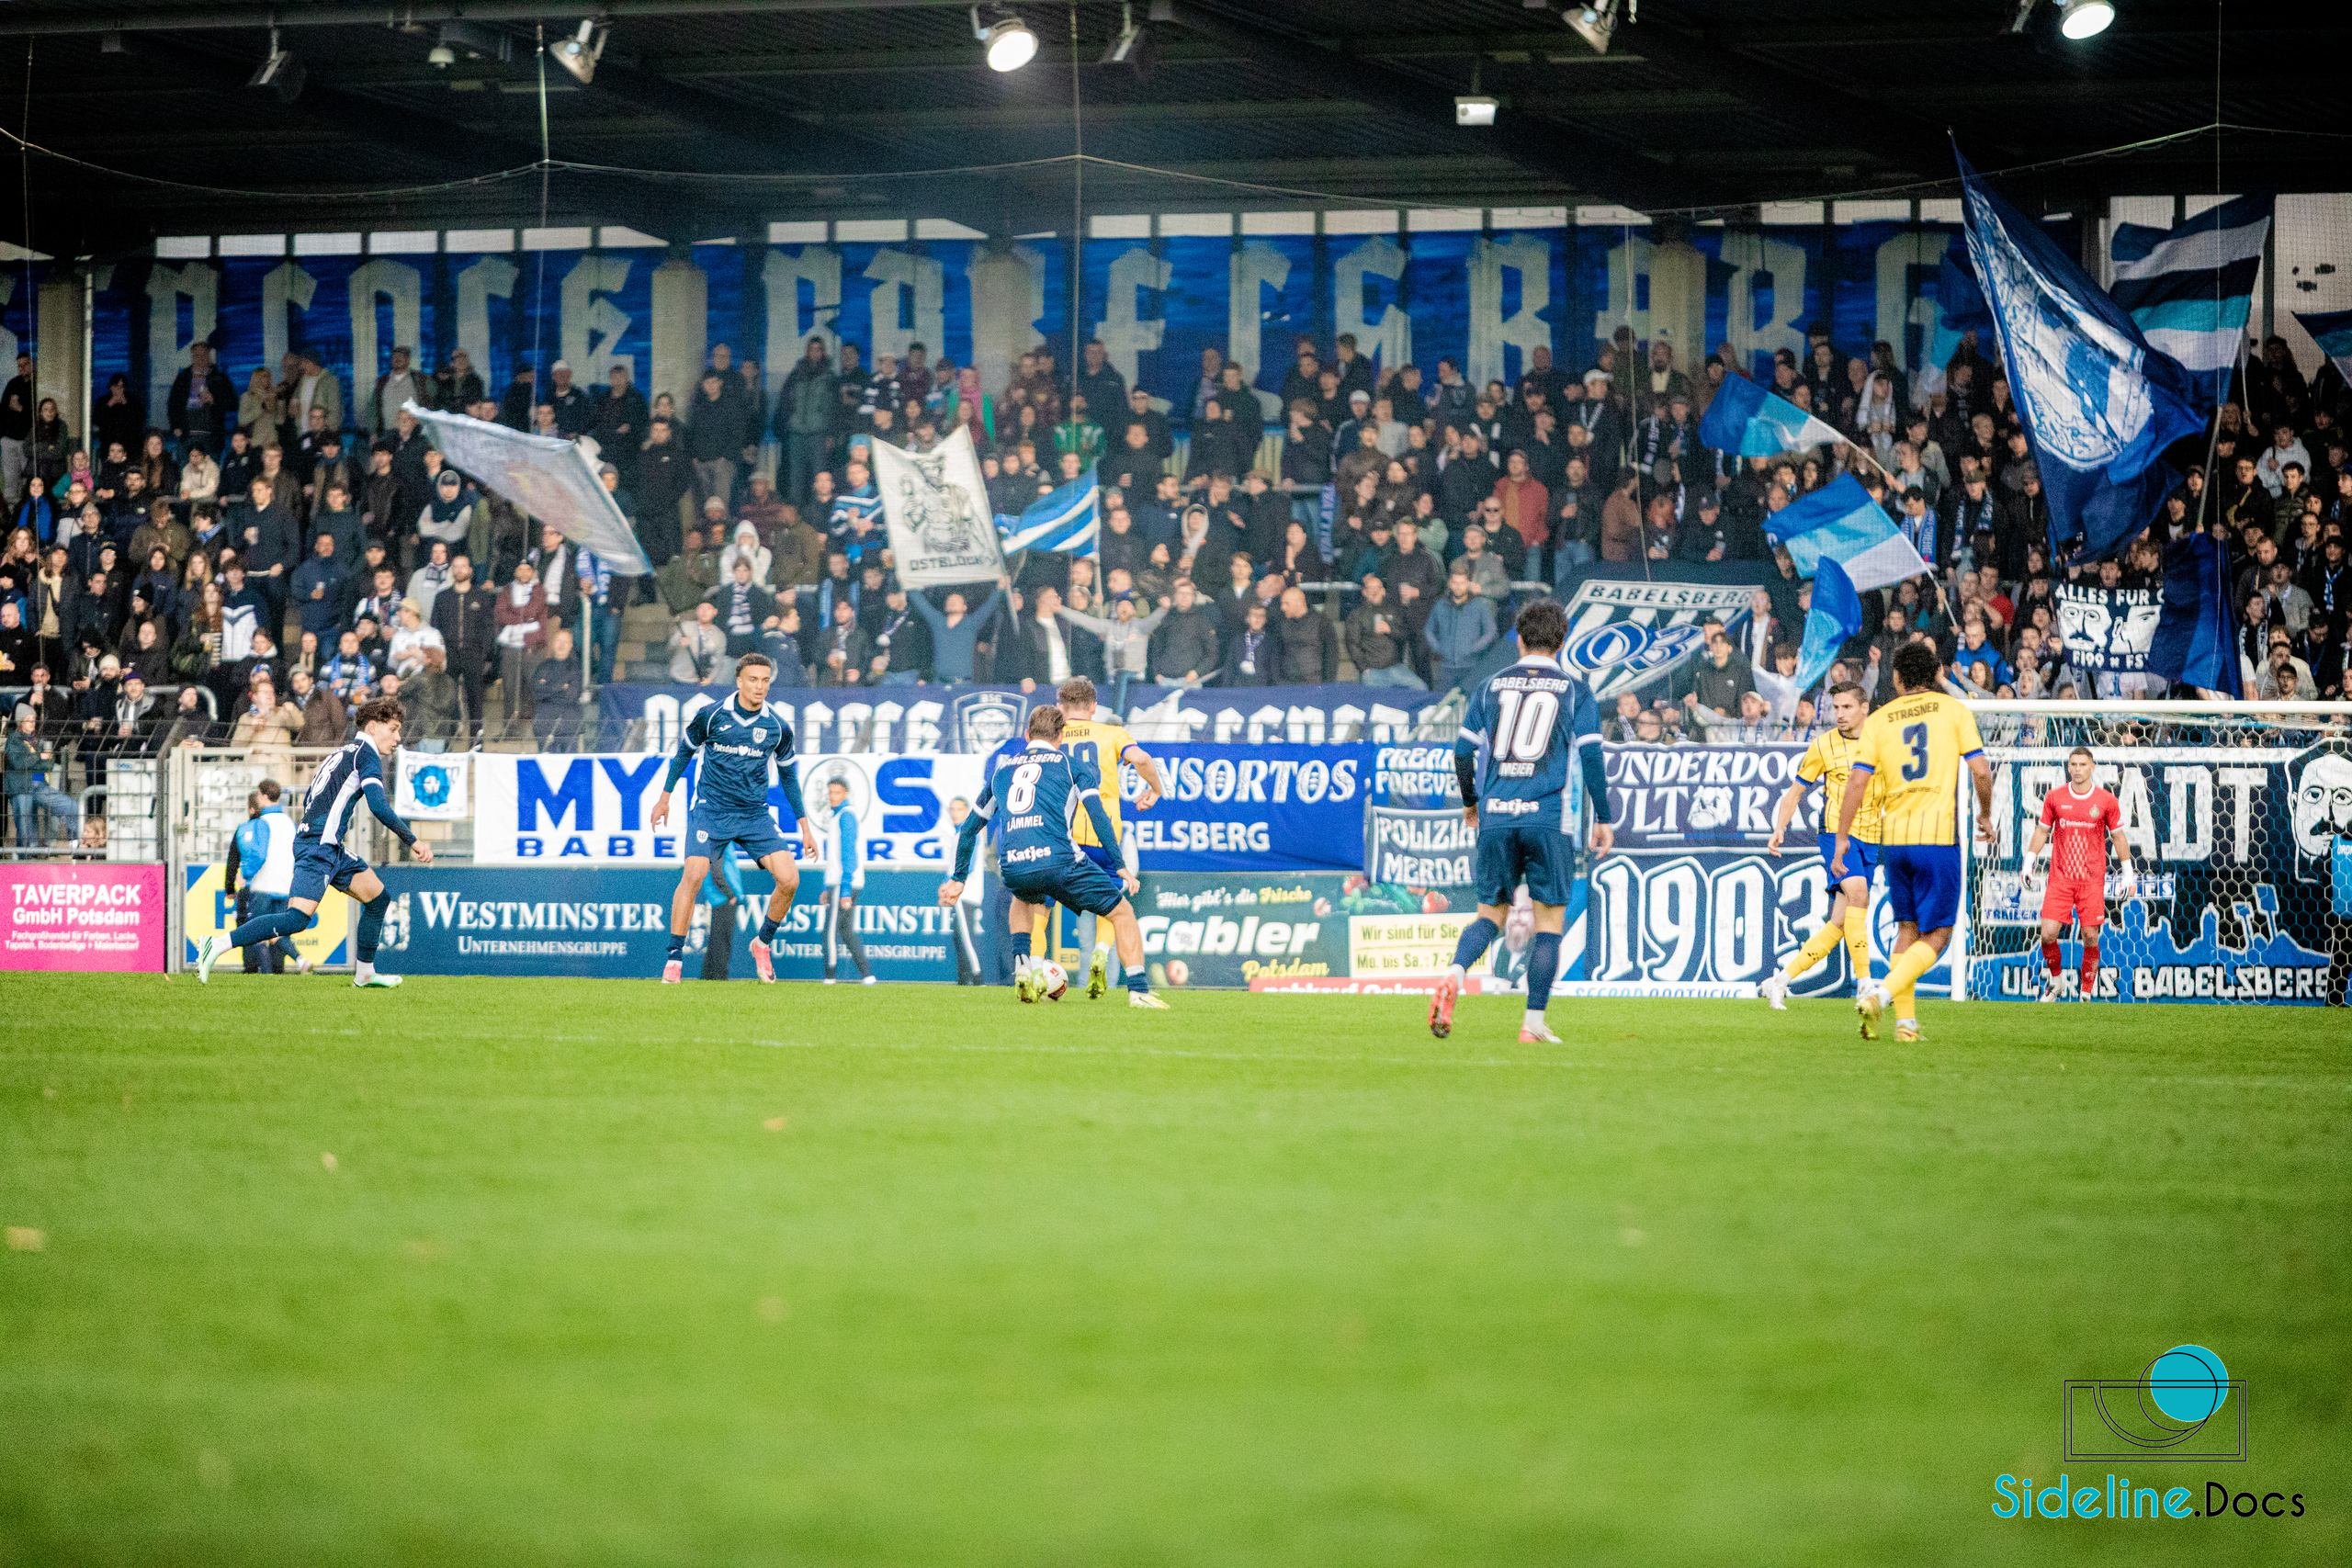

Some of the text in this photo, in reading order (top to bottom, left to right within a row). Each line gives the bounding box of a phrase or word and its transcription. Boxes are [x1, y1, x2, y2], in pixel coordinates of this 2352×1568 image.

[1589, 584, 1751, 604] BABELSBERG
[2055, 583, 2108, 605] ALLES
[1570, 620, 1703, 674] 03
[2126, 653, 2149, 669] FS
[1490, 677, 1569, 694] BABELSBERG
[1887, 702, 1939, 723] STRASNER
[1493, 690, 1559, 761] 10
[1902, 721, 1928, 782] 3
[1499, 762, 1535, 777] MEIER
[1007, 763, 1042, 814] 8
[1486, 798, 1540, 816] Katjes
[1007, 845, 1051, 863] Katjes
[1383, 852, 1473, 886] MERDA
[11, 884, 142, 906] TAVERPACK
[1234, 887, 1258, 905] die
[1259, 886, 1312, 904] Frische
[13, 907, 141, 925] GmbH Potsdam
[419, 891, 665, 931] WESTMINSTER
[1137, 916, 1320, 954] Gabler
[1361, 923, 1459, 941] Wir sind für Sie
[1595, 858, 1840, 992] 1903
[459, 935, 627, 956] UNTERNEHMENSGRUPPE
[1241, 958, 1330, 982] Potsdam
[1357, 954, 1379, 969] Mo.
[1383, 955, 1399, 968] bis
